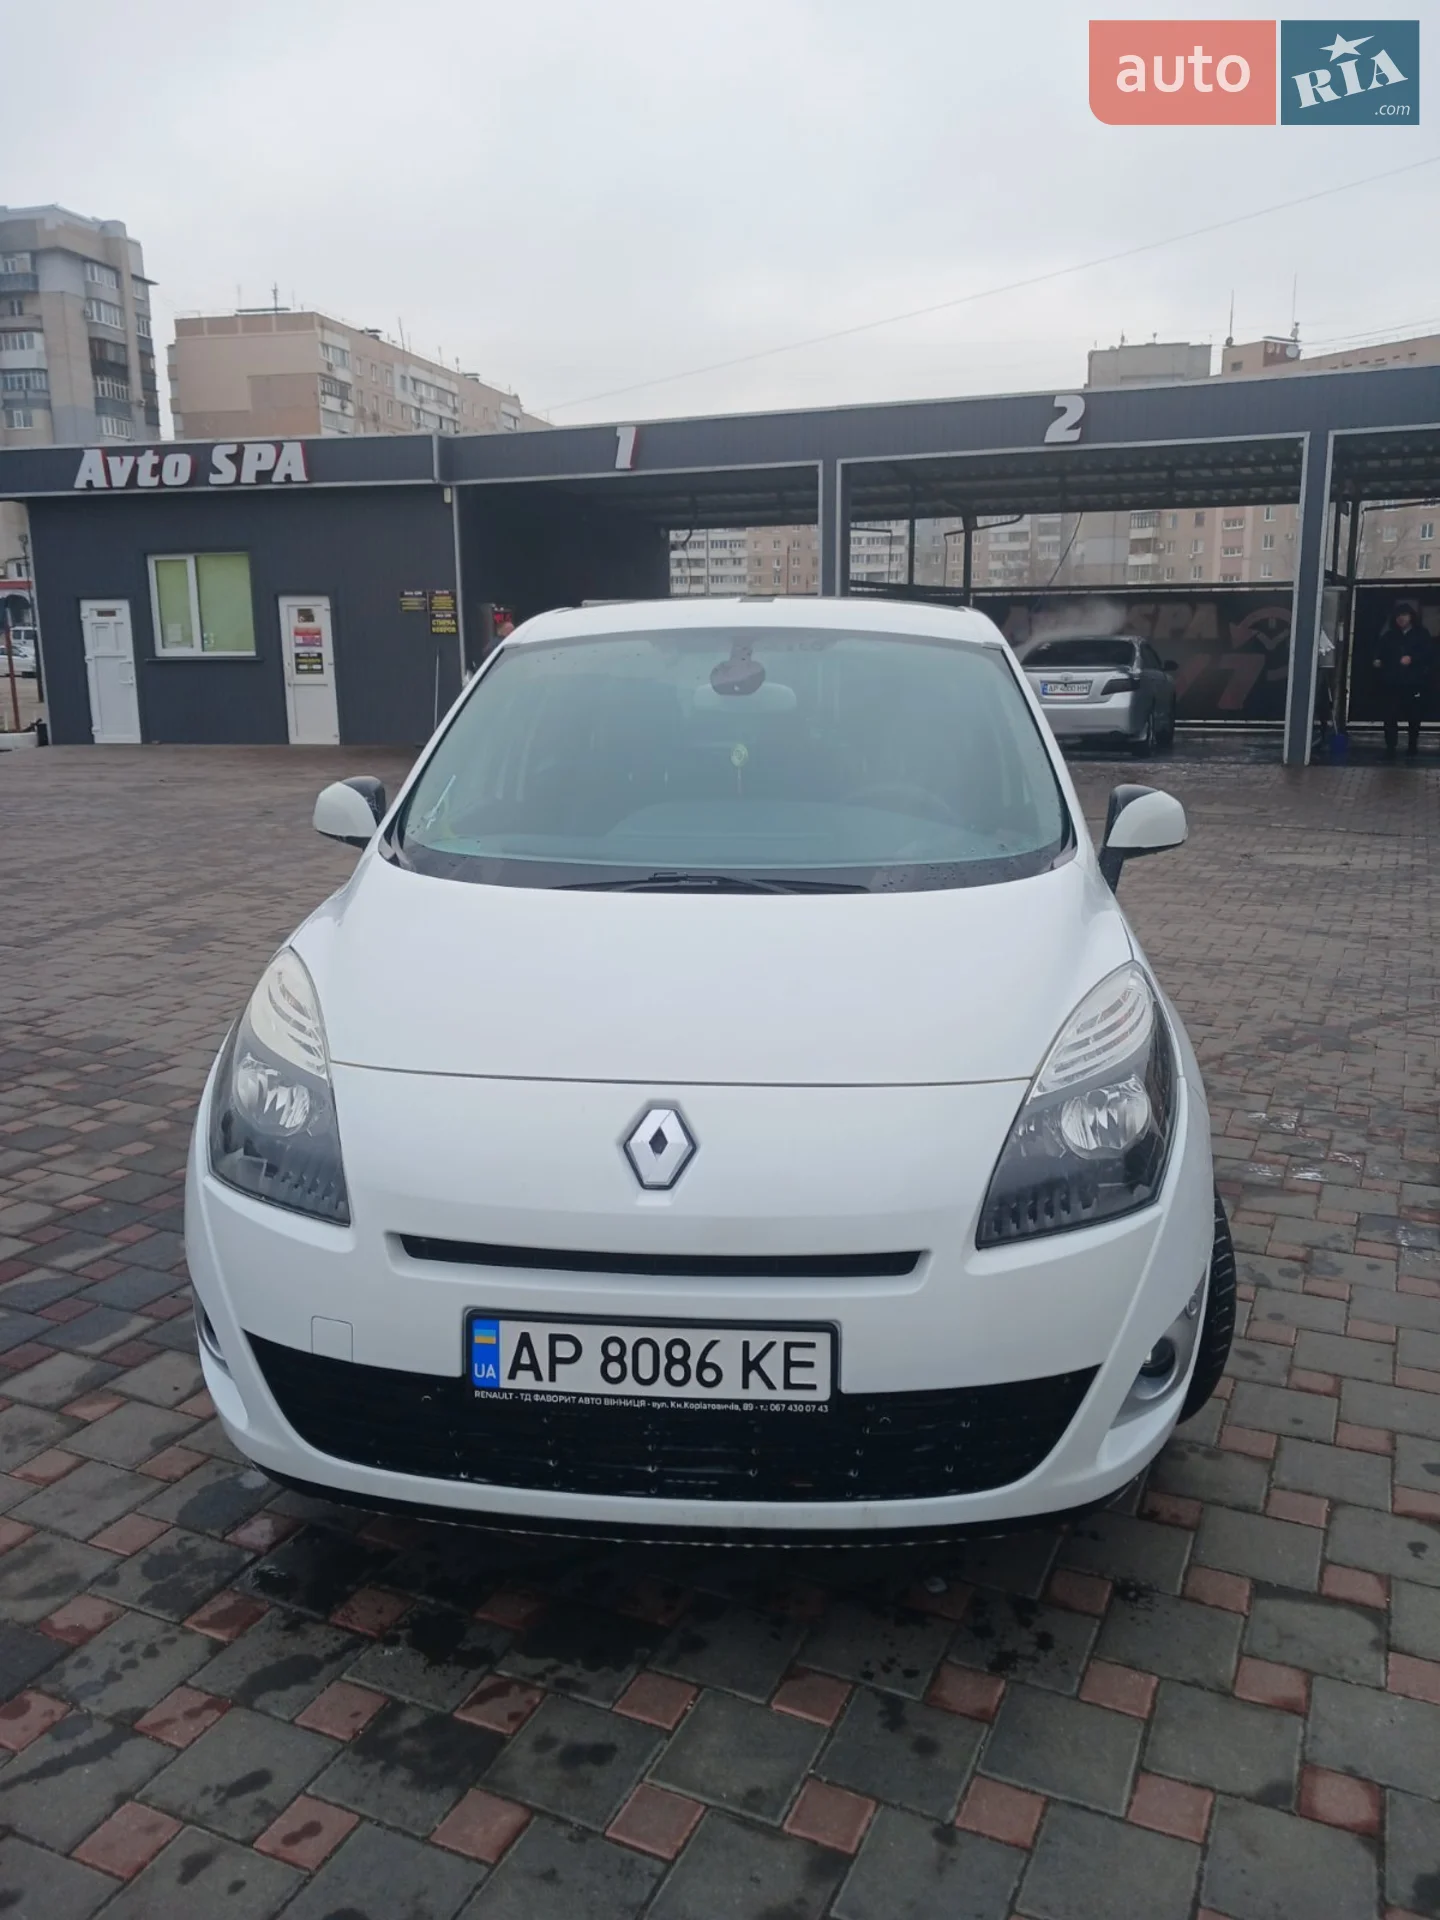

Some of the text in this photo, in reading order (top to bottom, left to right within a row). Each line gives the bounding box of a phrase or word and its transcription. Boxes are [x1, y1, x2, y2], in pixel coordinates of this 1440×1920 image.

[1044, 395, 1086, 443] 2
[73, 441, 308, 489] Avto SPA
[615, 426, 638, 470] 1
[474, 1363, 497, 1380] UA
[507, 1331, 818, 1391] AP 8086 KE
[474, 1390, 514, 1400] RENAULT
[519, 1392, 532, 1402] ТД
[533, 1393, 577, 1404] ФАВОРИТ
[578, 1396, 602, 1405] АВТО
[603, 1397, 646, 1408] ВІННИЦЯ
